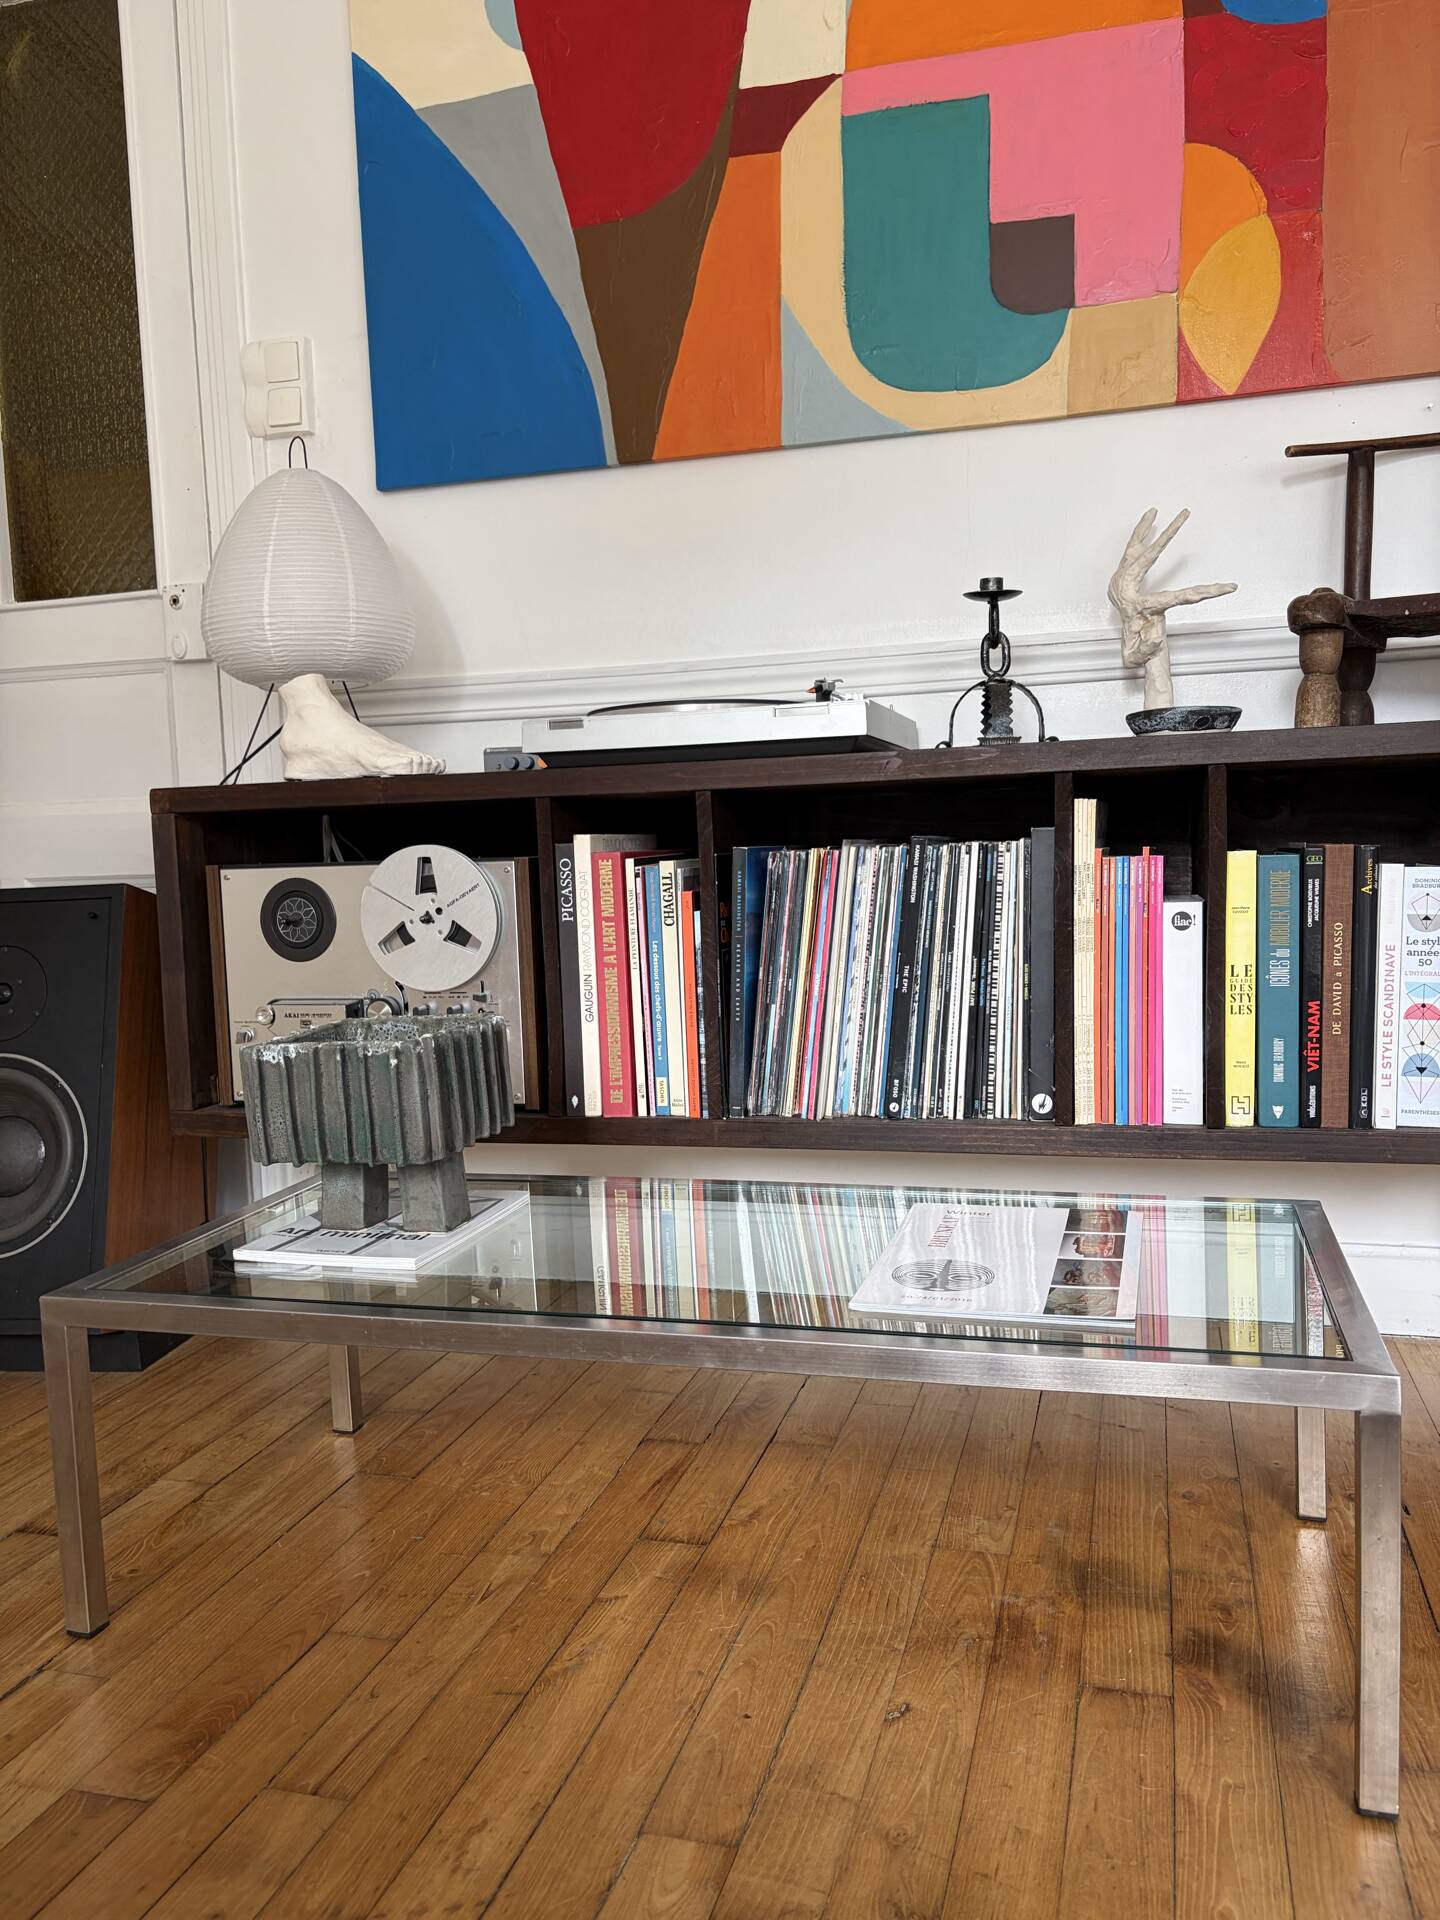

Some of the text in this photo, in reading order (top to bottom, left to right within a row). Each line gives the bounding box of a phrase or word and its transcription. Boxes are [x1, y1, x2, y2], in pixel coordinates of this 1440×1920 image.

[910, 844, 921, 903] KAMASI WASHINGTON
[1269, 869, 1290, 907] MODERNE
[1360, 858, 1374, 895] Archives
[561, 857, 574, 922] PICASSO
[663, 872, 675, 927] CHAGALL
[628, 888, 636, 925] FLAMANDE
[1174, 914, 1196, 927] fiac!
[1269, 910, 1290, 946] MOBILIER
[1406, 936, 1440, 949] Le styl
[582, 918, 593, 973] RAYMOND
[1333, 922, 1343, 966] PICASSO
[1406, 945, 1440, 957] année
[632, 961, 638, 970] LA
[653, 953, 661, 980] dessous
[903, 965, 911, 978] THE
[1230, 964, 1253, 978] LE
[1266, 960, 1290, 987] ICÔNES
[1418, 959, 1433, 967] 50
[600, 859, 624, 1104] DE L'IMPRESSIONNISME A L'ART MODERNE
[654, 981, 662, 993] des
[1229, 983, 1253, 992] DES
[584, 973, 595, 1024] GAUGUIN
[1230, 992, 1253, 1004] STY
[1230, 1004, 1253, 1015] LES
[1332, 982, 1342, 1015] DAVID
[655, 994, 664, 1042] chefs-d'œuvre
[1332, 1021, 1342, 1035] DE
[1381, 944, 1396, 1087] LE STYLE SCANDINAVE
[1303, 1000, 1321, 1072] VIÊT-NAM
[319, 1229, 431, 1241] minimal
